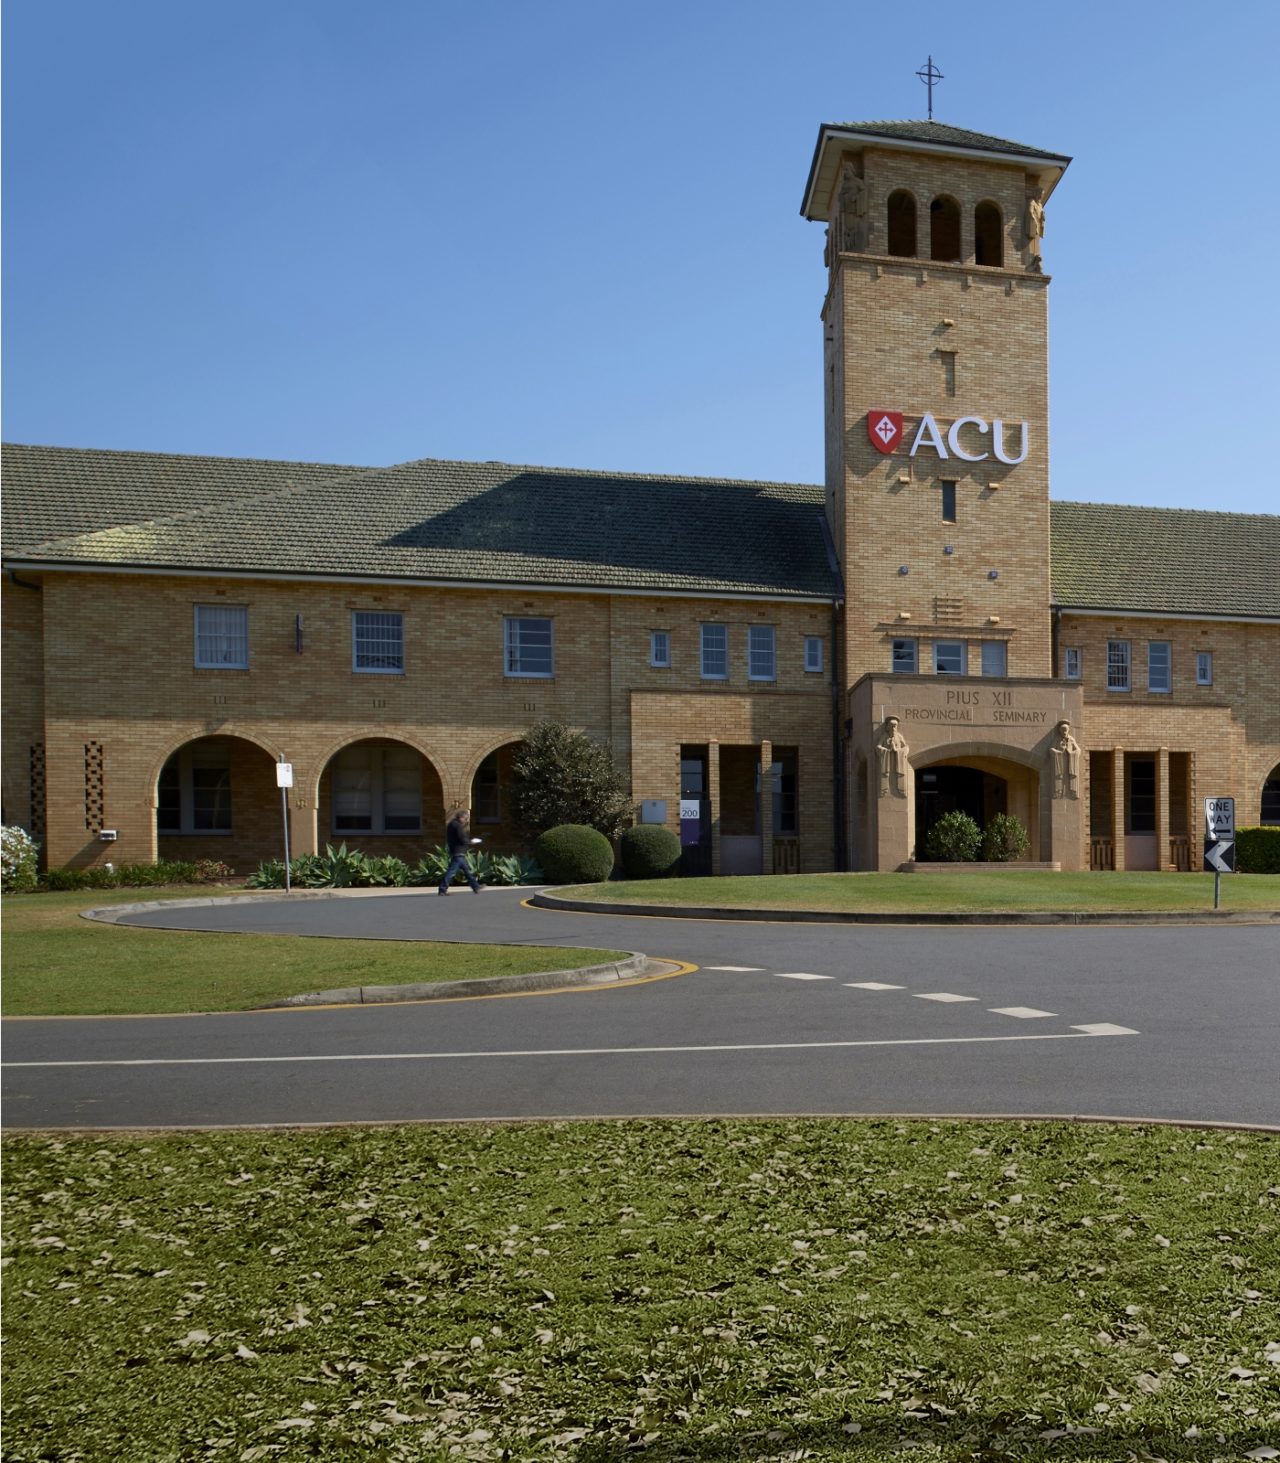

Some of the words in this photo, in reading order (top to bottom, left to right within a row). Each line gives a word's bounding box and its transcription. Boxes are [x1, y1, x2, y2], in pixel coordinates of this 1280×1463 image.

[909, 411, 1028, 465] ACU
[946, 690, 980, 704] PIUS
[992, 692, 1011, 706] XII
[904, 708, 972, 720] PROVINCIAL
[993, 710, 1047, 722] SEMINARY
[1209, 802, 1230, 812] ONE
[1209, 814, 1231, 824] WAY
